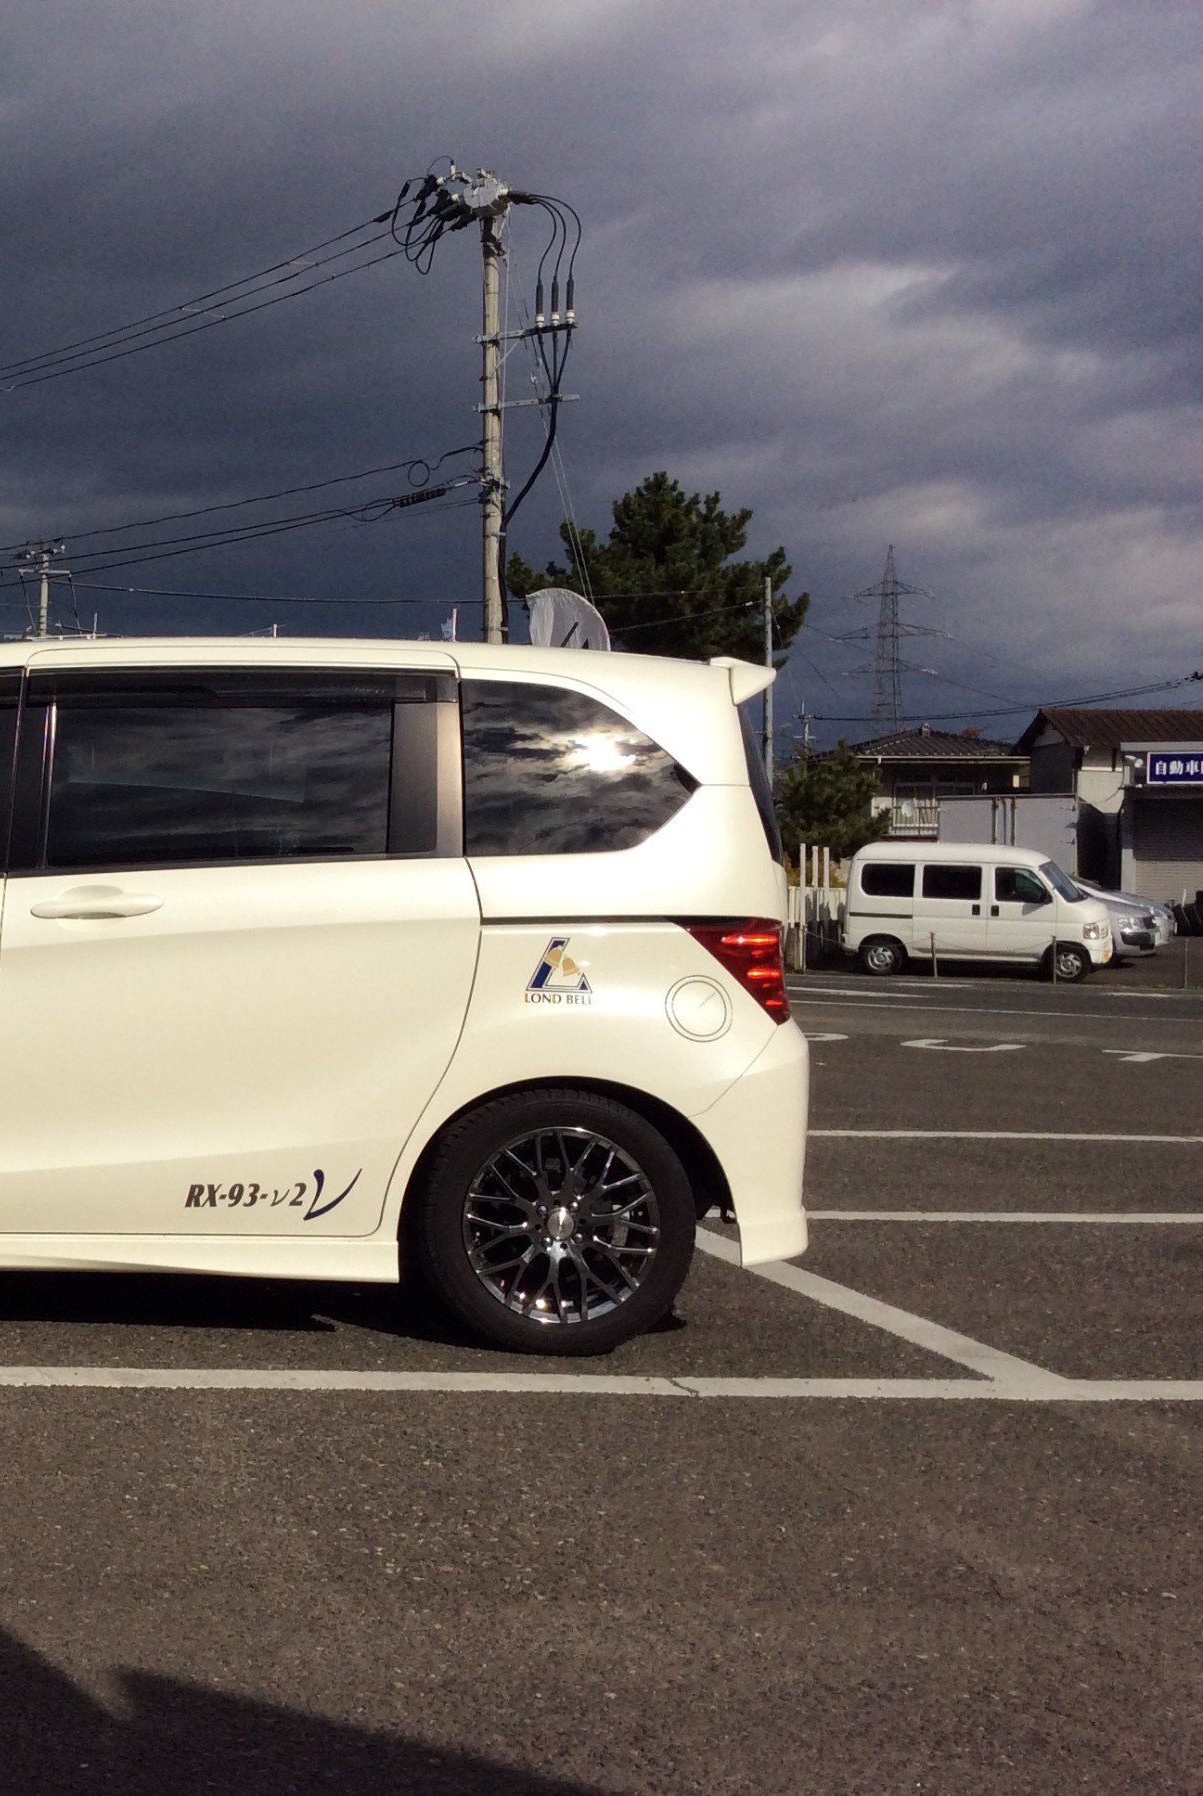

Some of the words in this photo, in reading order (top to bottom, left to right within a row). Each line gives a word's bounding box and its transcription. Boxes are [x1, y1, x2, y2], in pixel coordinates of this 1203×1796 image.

[1155, 760, 1203, 776] 自動車
[524, 993, 562, 1004] LOND
